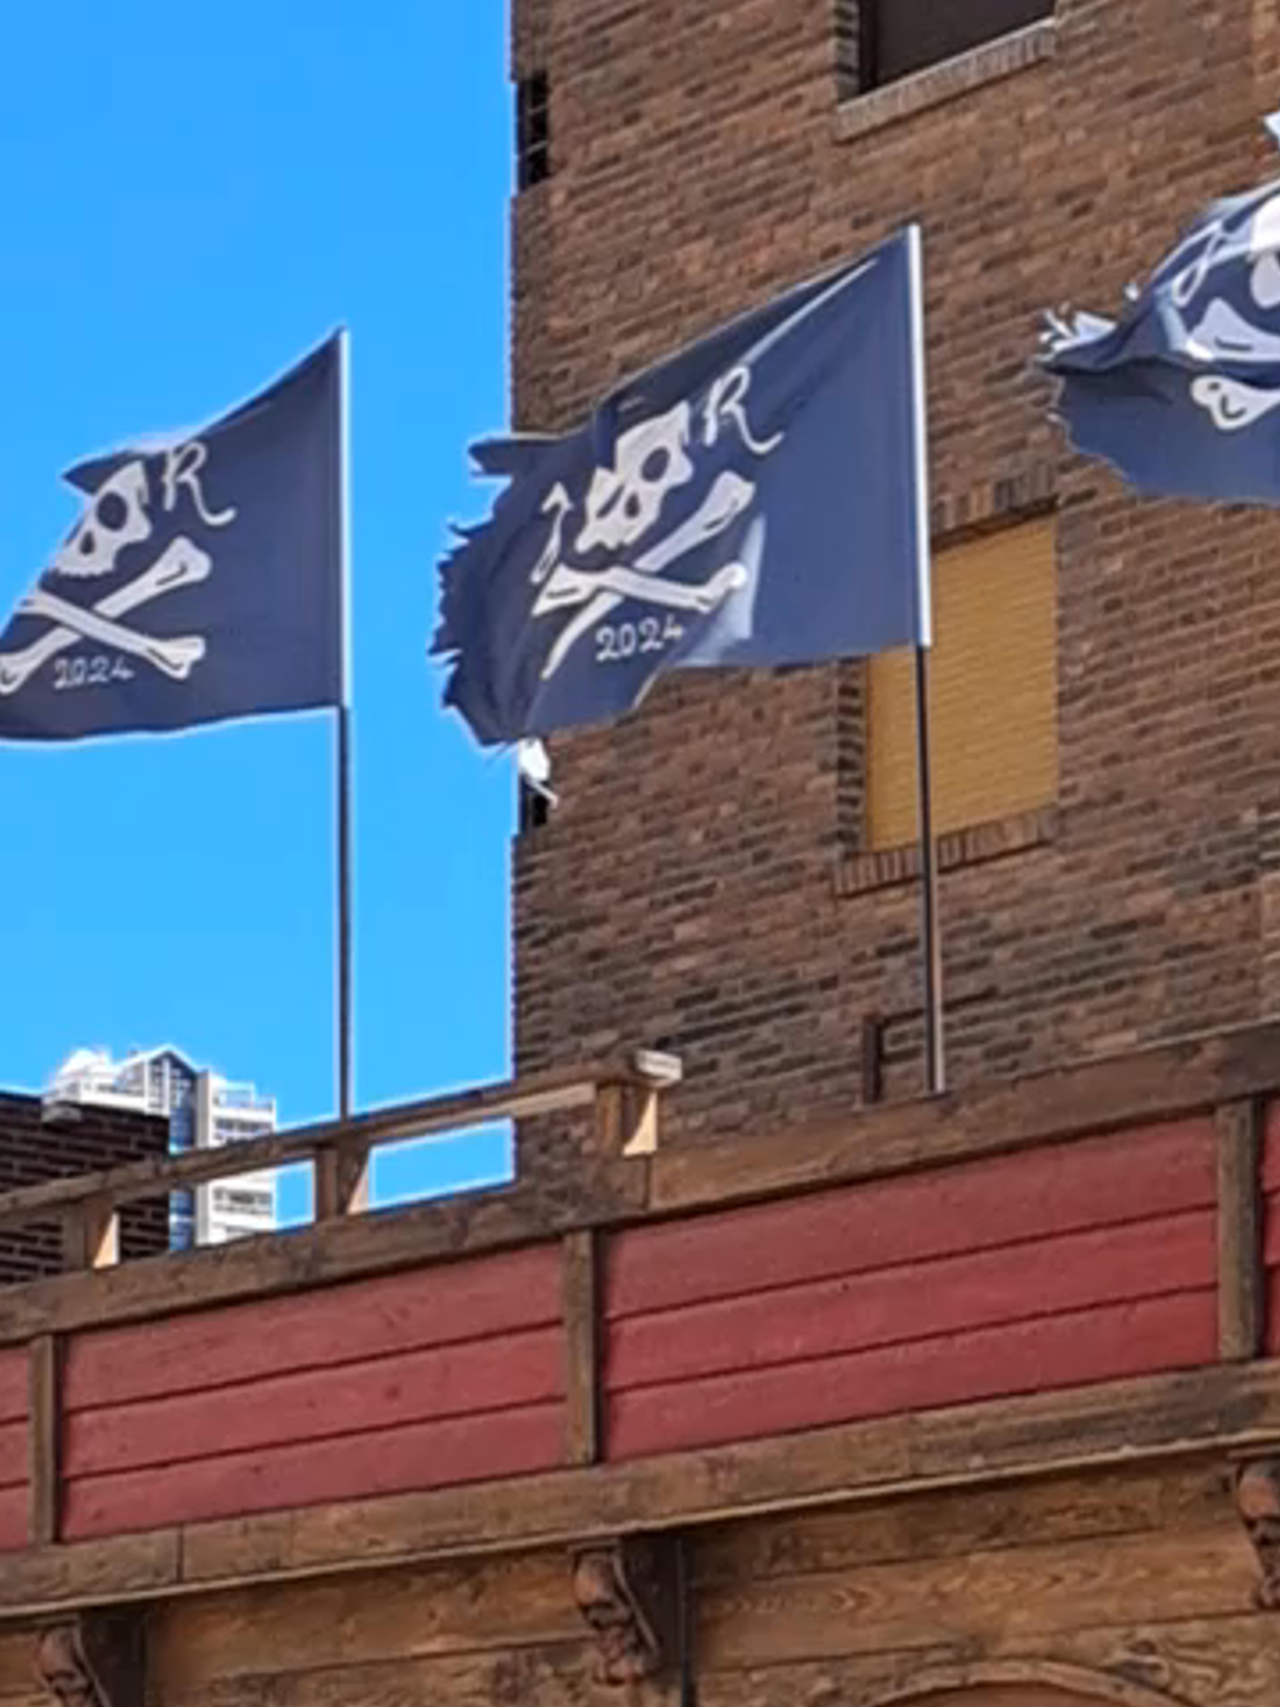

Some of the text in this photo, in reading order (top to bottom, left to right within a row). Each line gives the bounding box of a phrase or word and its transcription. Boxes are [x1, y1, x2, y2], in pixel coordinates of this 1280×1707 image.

[702, 364, 783, 454] R
[162, 440, 237, 527] R
[52, 654, 135, 691] 2024
[594, 620, 686, 662] 2024
